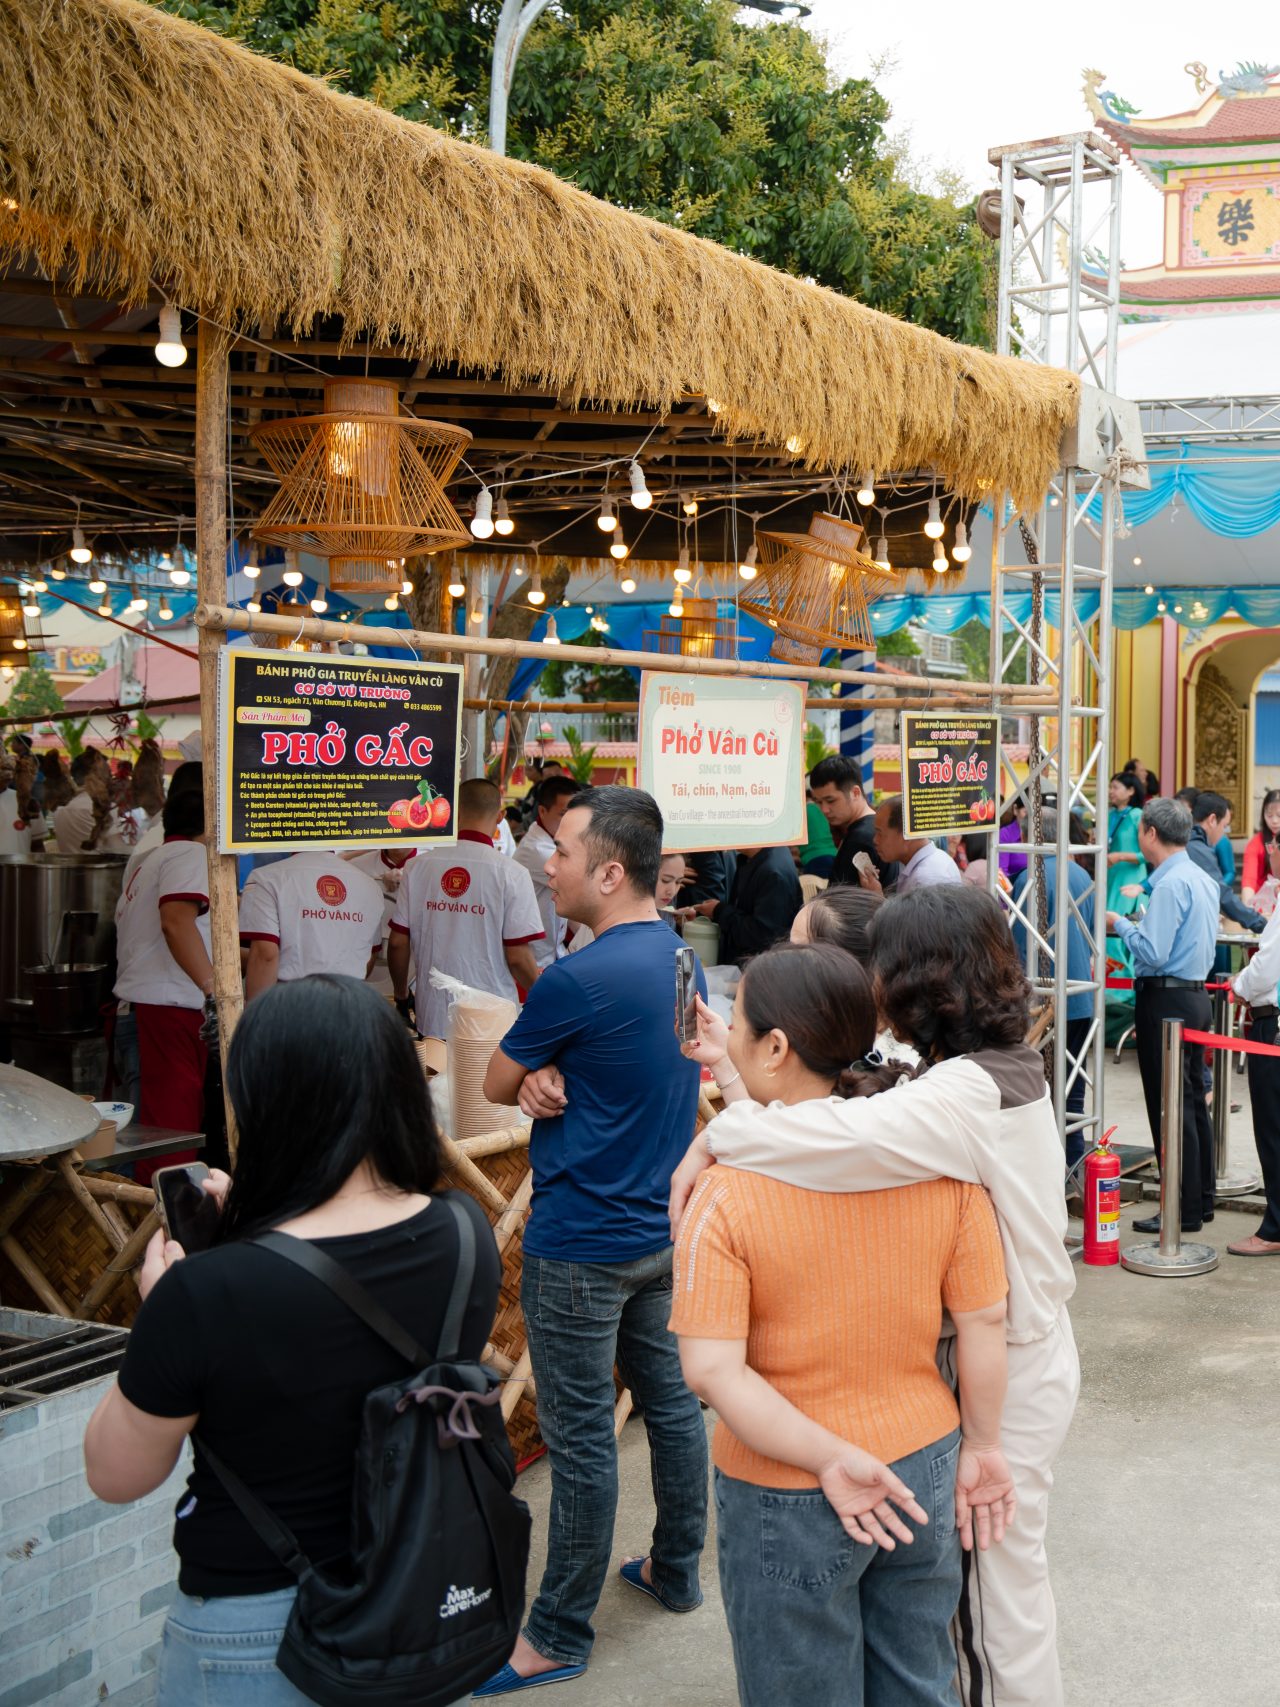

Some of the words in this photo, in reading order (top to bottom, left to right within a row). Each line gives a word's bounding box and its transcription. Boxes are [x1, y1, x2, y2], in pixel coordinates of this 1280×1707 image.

[257, 665, 289, 677] BÁNH
[292, 665, 316, 679] PHỞ
[318, 669, 336, 680] GIA
[338, 668, 379, 683] TRUYỀN
[381, 673, 407, 685] LÀNG
[409, 674, 428, 686] VÂN
[430, 676, 443, 687] CÙ
[294, 682, 315, 695] CƠ
[317, 681, 335, 697] SỞ
[658, 686, 695, 710] Tiệm
[272, 696, 282, 704] 53,
[262, 721, 346, 766] PHỞ
[355, 722, 433, 766] GẤC
[661, 722, 703, 755] Phở
[708, 729, 746, 756] Vân
[753, 731, 778, 756] Cù
[699, 764, 721, 774] SINCE
[918, 754, 953, 783] PHỞ
[956, 752, 988, 782] GẤC
[672, 783, 690, 798] Tái,
[693, 782, 718, 798] chín,
[721, 784, 747, 799] Nạm,
[750, 780, 770, 796] Gầu
[302, 908, 326, 920] PHỞ
[329, 910, 350, 920] VÂN
[426, 900, 446, 911] PHỞ
[448, 902, 468, 913] VÂN
[471, 904, 485, 915] CÙ
[447, 1586, 475, 1605] Max
